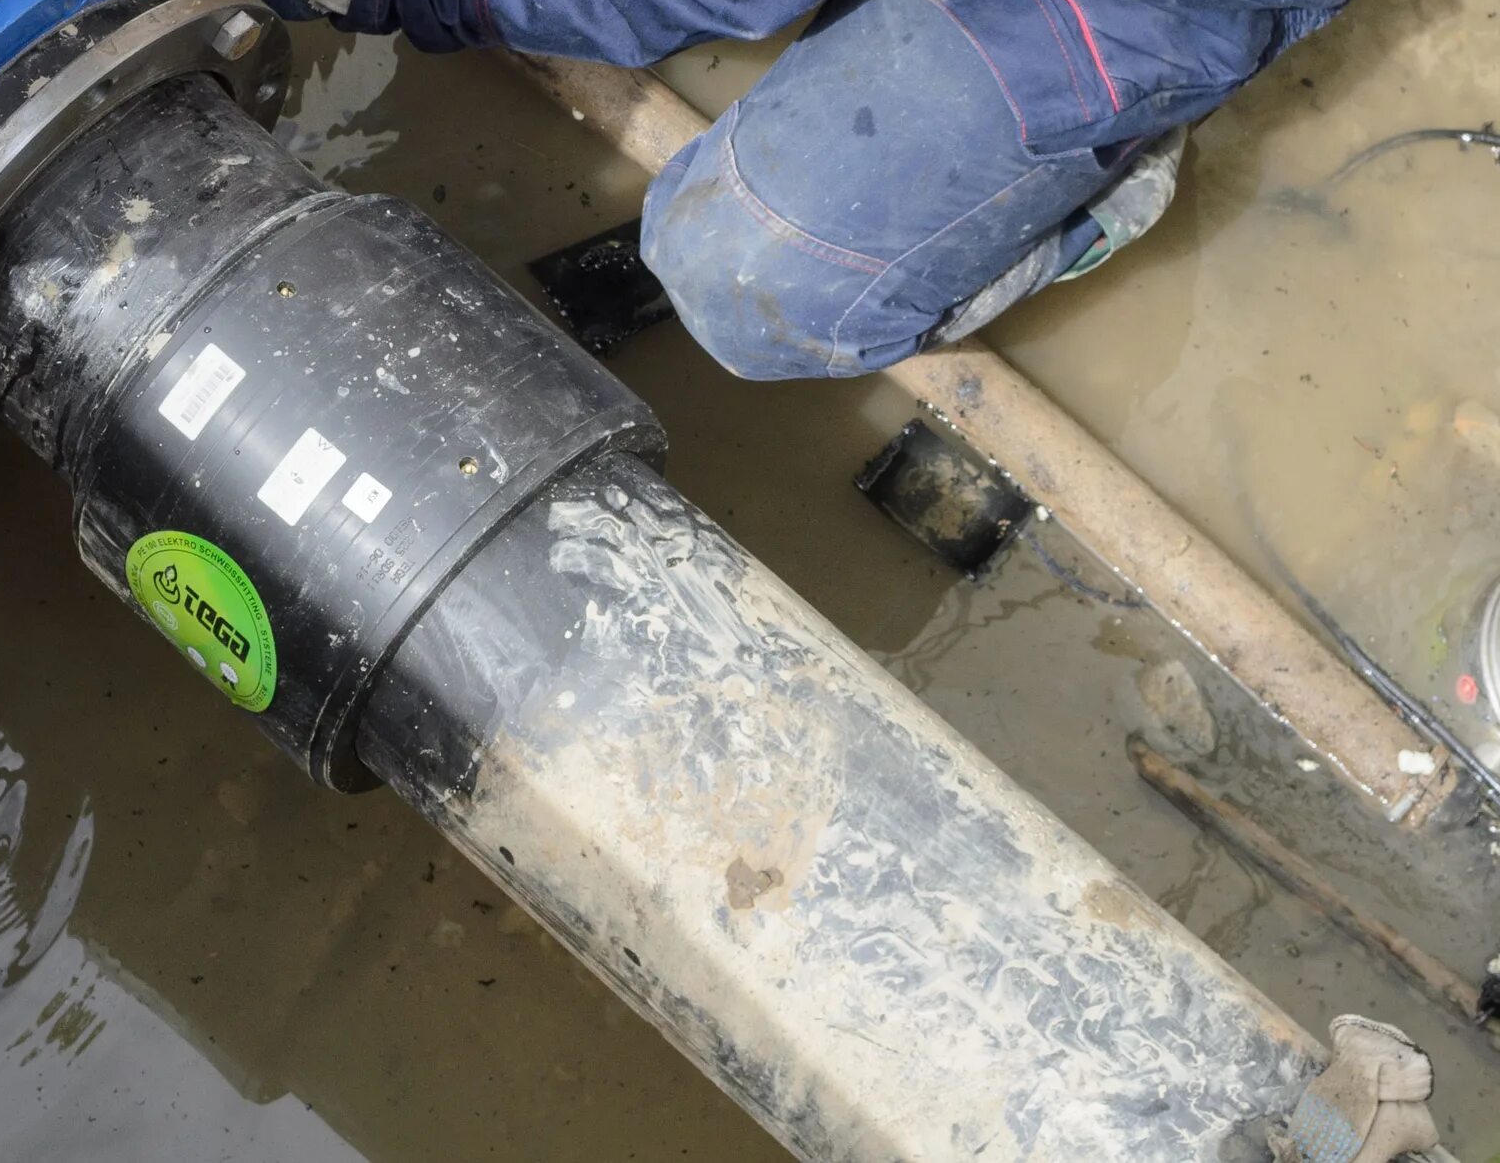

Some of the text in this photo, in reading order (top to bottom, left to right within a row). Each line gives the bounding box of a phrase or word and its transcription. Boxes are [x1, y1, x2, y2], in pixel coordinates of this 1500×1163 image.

[158, 537, 196, 551] ELEKTRO
[198, 544, 263, 621] SCHWEISSFITTING
[260, 629, 273, 677] SYSTEME
